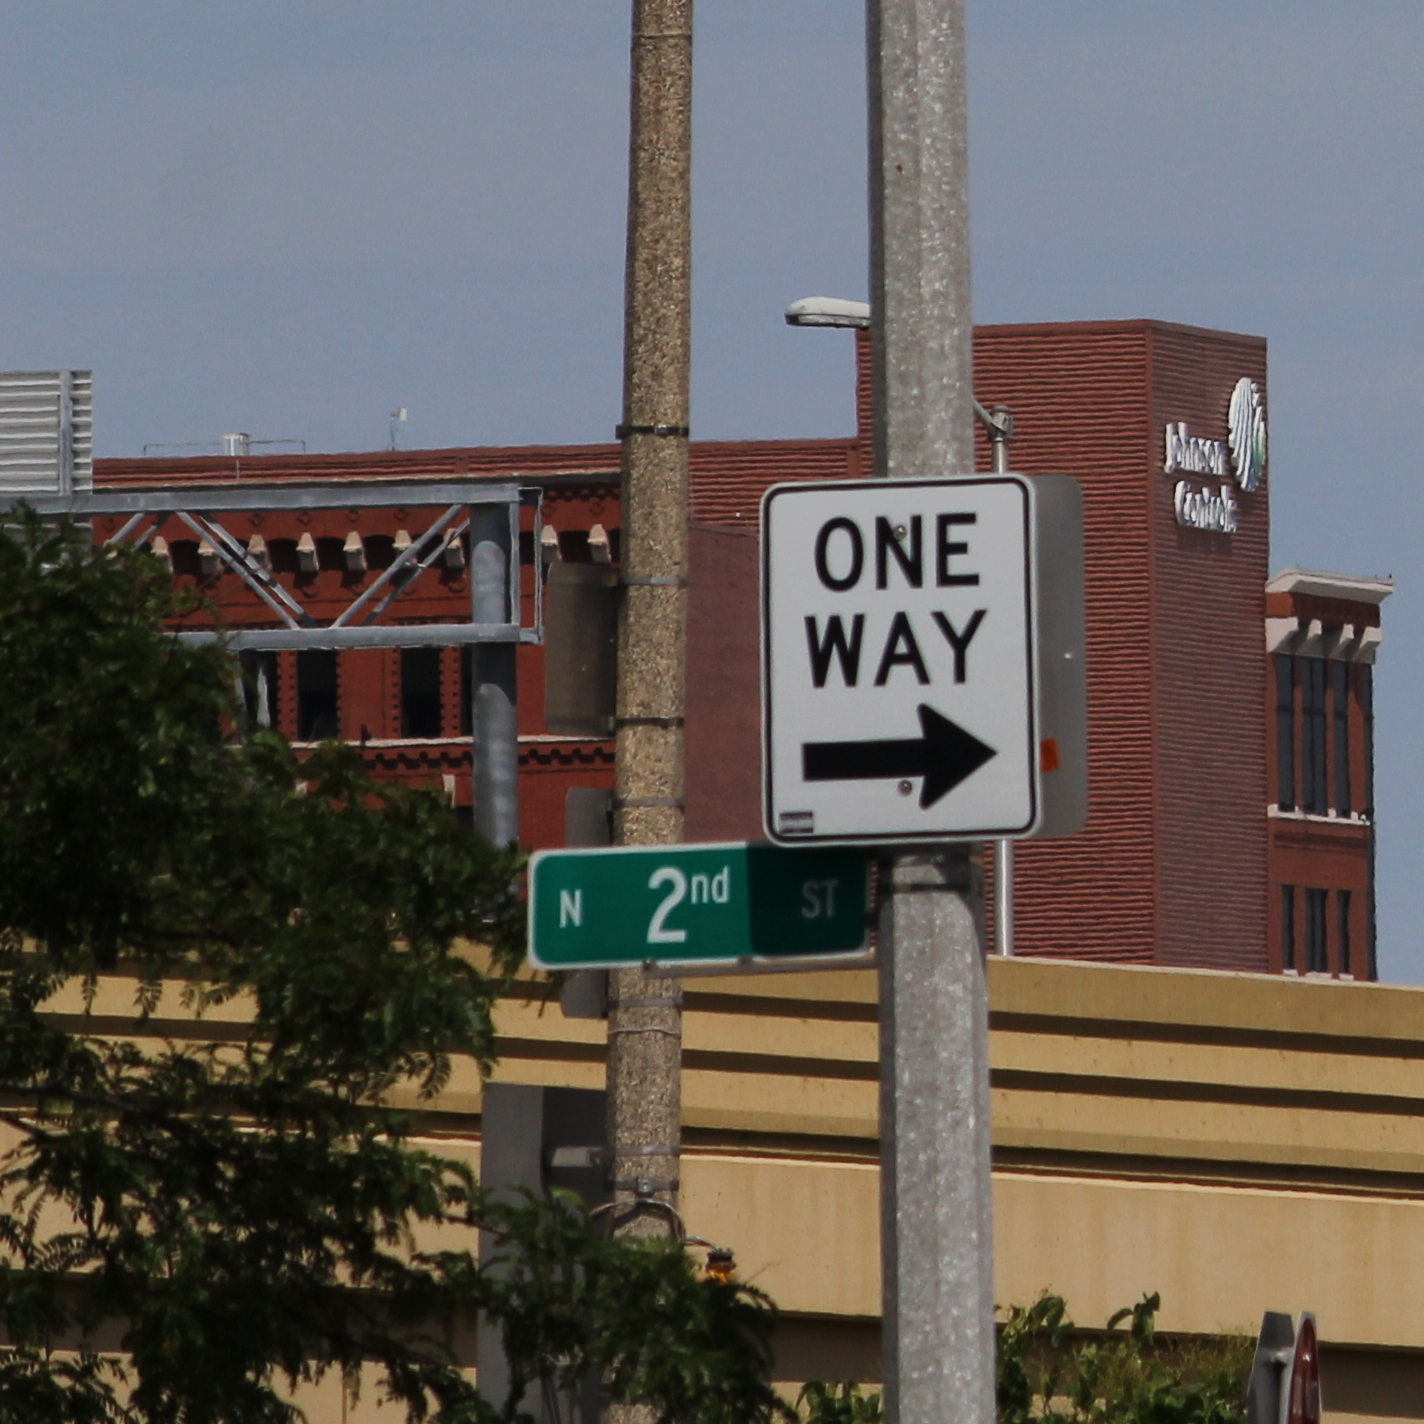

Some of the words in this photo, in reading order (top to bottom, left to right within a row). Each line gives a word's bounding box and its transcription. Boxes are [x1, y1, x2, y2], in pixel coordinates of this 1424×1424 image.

[1164, 422, 1225, 475] Johnson
[1174, 480, 1237, 533] Controls
[814, 513, 980, 592] ONE
[804, 609, 988, 688] WAY
[559, 889, 582, 928] N
[647, 865, 730, 943] 2nd
[801, 878, 838, 918] ST
